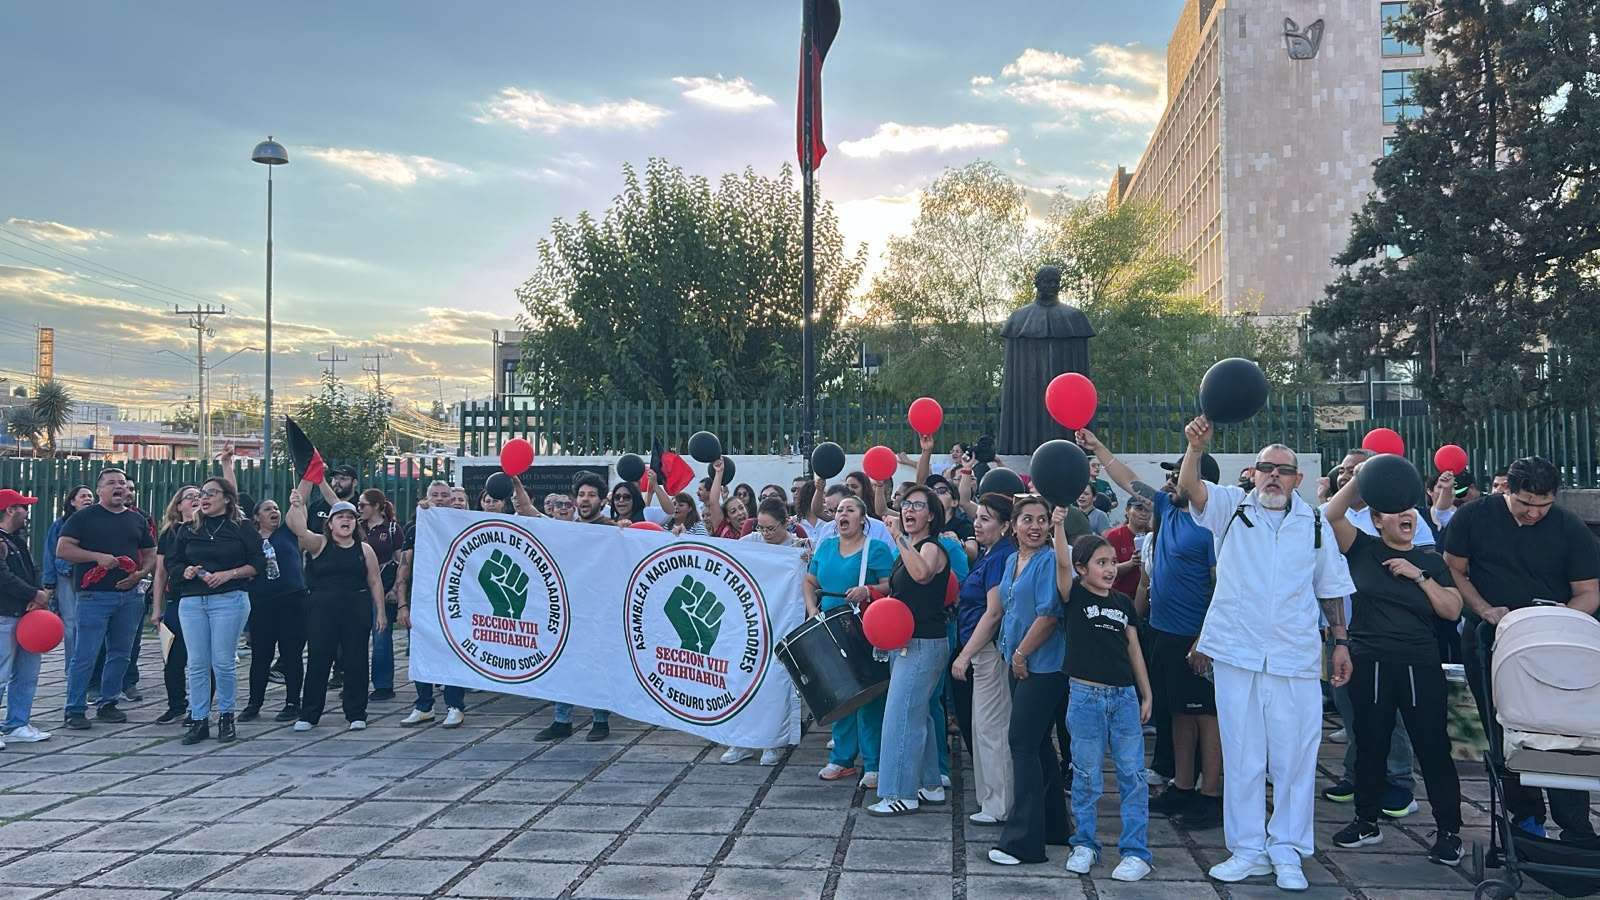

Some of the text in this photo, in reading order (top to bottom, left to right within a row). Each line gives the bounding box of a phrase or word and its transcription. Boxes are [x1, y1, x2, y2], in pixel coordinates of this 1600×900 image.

[448, 531, 561, 635] ASAMBLEA NACIONAL DE TRABAJADORES
[472, 613, 539, 635] SECCION VIII
[632, 554, 759, 674] ASAMBLEA NACIONAL DE TRABAJADORES
[472, 628, 538, 649] CHIHUAHUA
[461, 638, 548, 671] DEL SEGURO SOCIAL
[655, 646, 729, 674] SECCION VIII
[657, 661, 727, 690] CHIHUAHUA
[647, 672, 736, 712] DEL SEGURO SOCIAL
